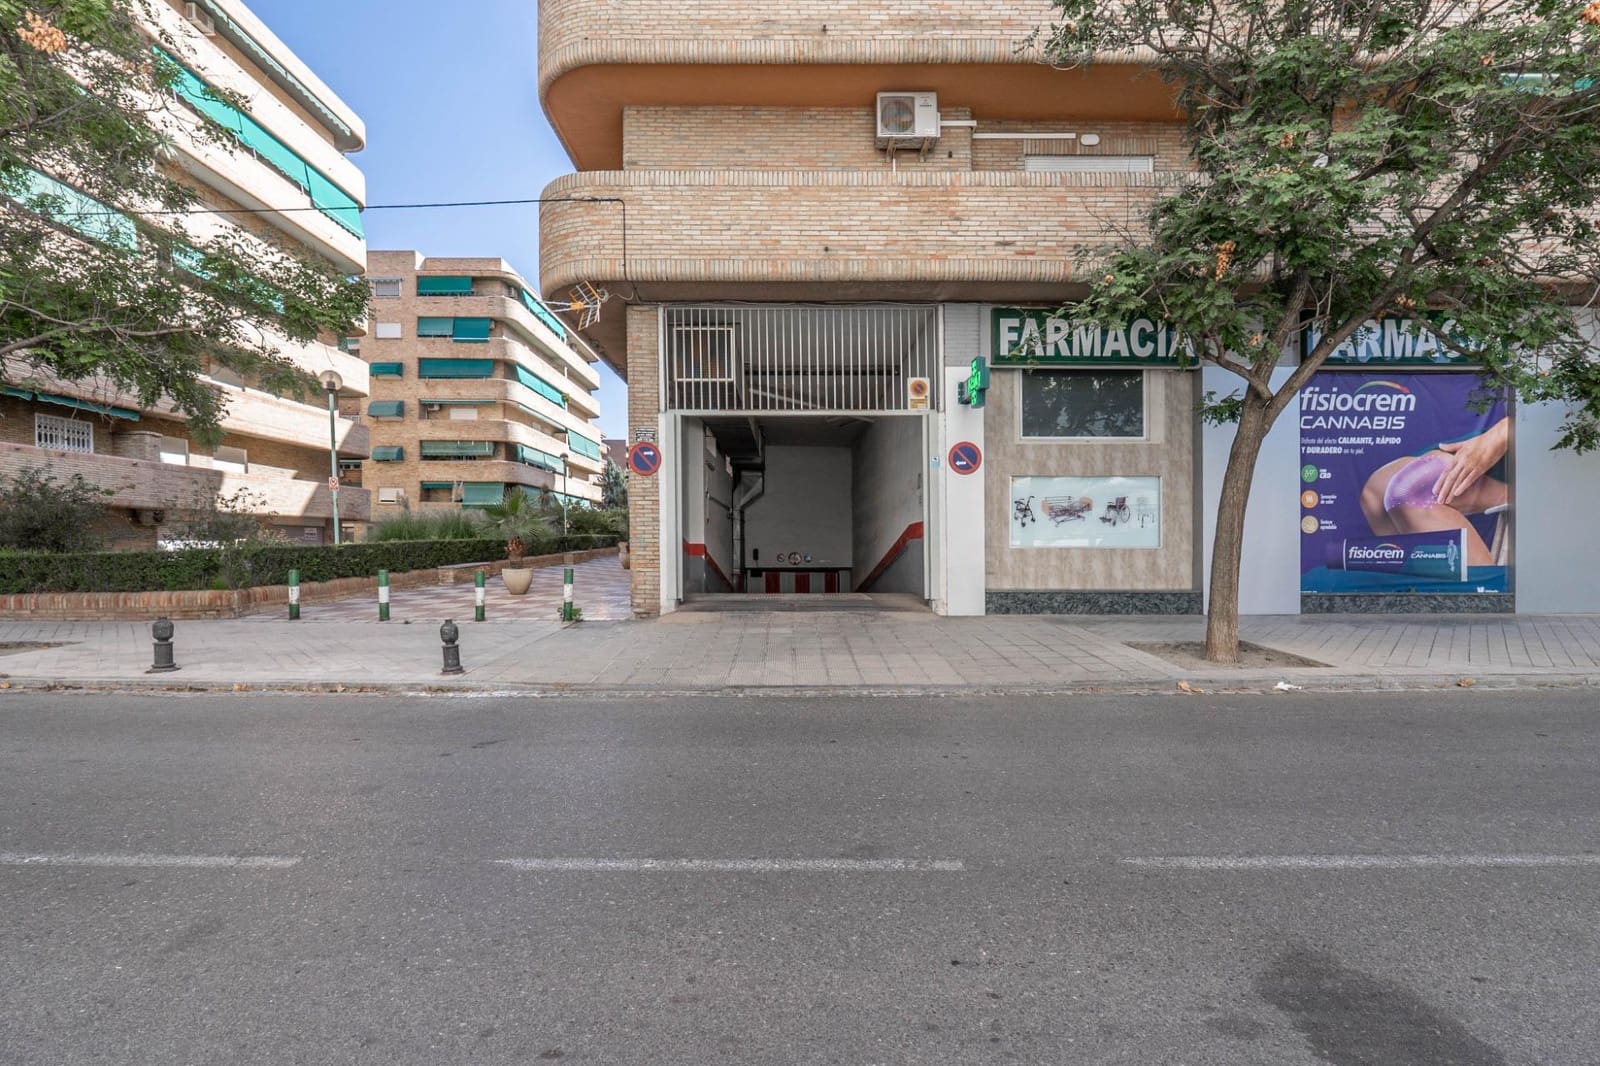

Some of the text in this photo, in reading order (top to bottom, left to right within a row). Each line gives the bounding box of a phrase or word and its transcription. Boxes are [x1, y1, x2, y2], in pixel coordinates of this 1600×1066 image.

[1000, 317, 1195, 358] FARMACIA
[1301, 387, 1416, 411] fisiocrem
[1300, 416, 1406, 430] CANNABIS
[1338, 437, 1374, 445] CALMANTE,
[1376, 435, 1401, 444] RÁPIDO
[1301, 446, 1306, 454] Y
[1306, 446, 1343, 454] DURADERO
[1348, 546, 1404, 559] fisiocrem
